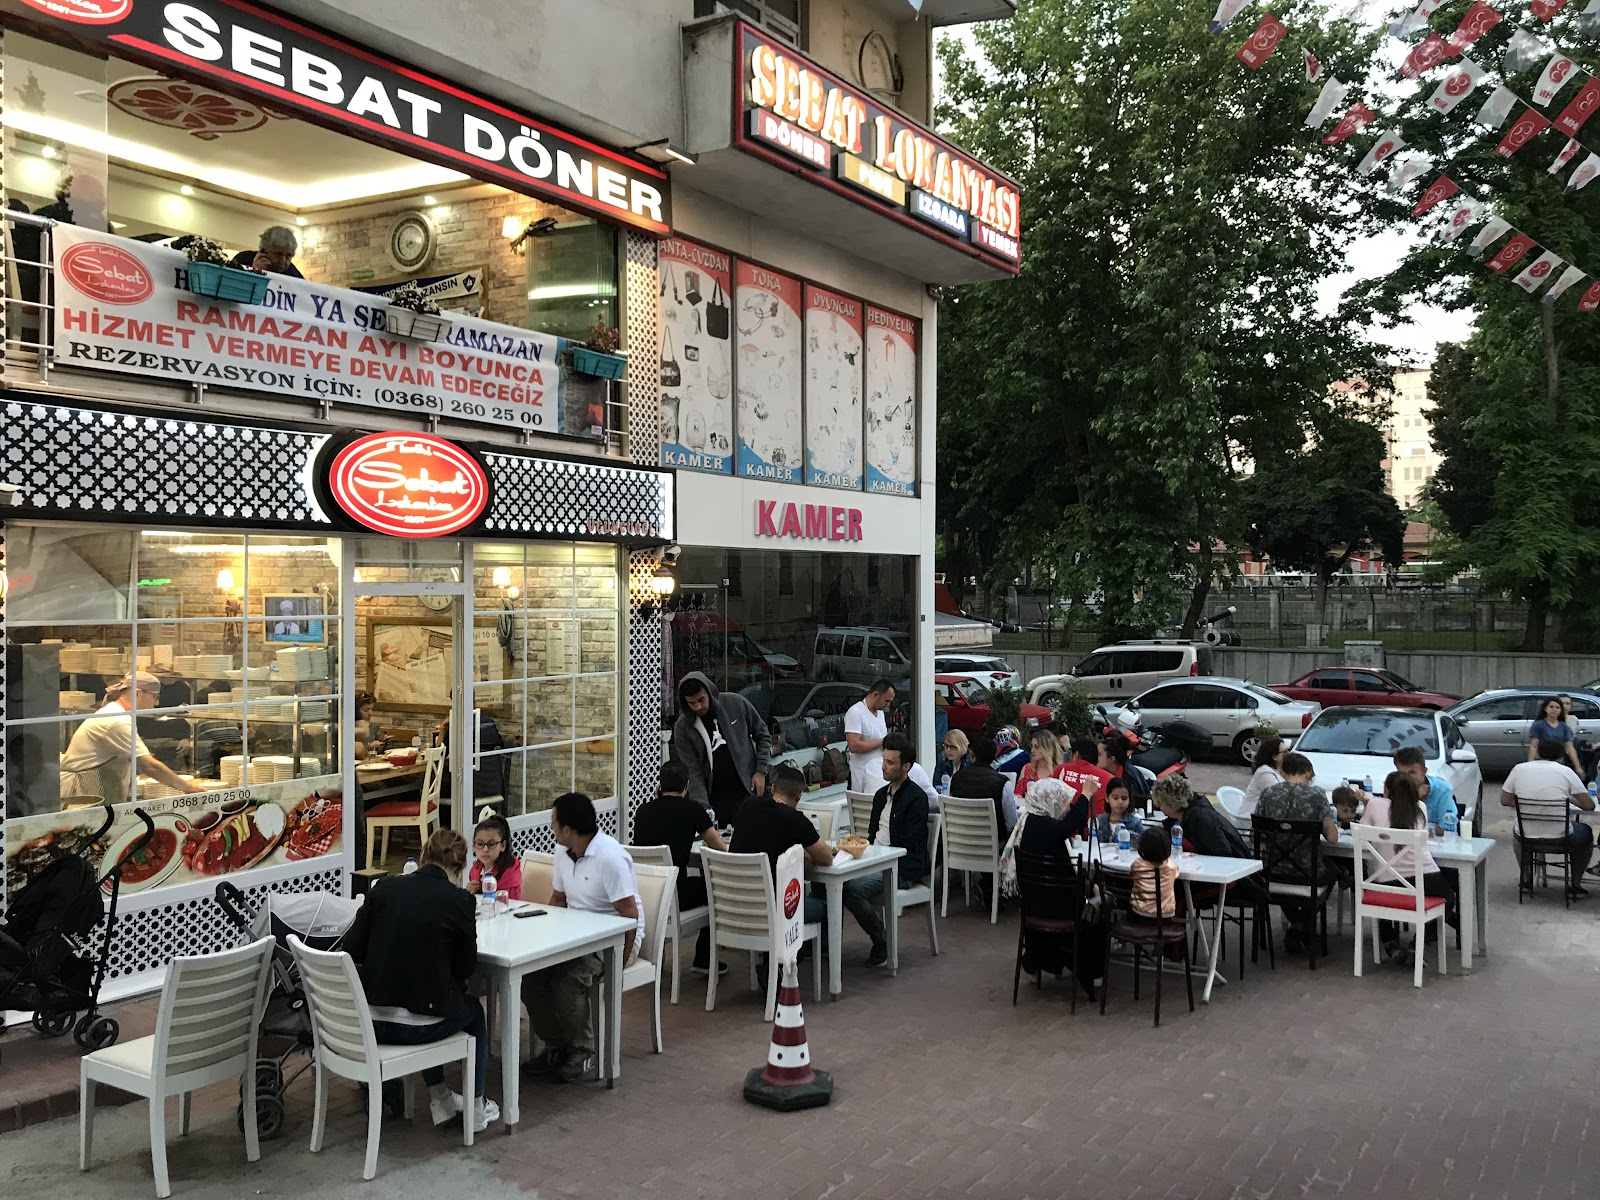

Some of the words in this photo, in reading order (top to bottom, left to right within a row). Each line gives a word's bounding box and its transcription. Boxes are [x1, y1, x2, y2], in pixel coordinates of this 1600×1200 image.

[163, 3, 441, 138] SEBAT
[464, 125, 662, 222] DÖNER
[751, 44, 867, 154] SEBAT
[875, 115, 1020, 237] LOKANTASI
[765, 116, 825, 165] DÖNER
[981, 226, 1018, 258] YEMEK
[72, 256, 144, 284] Sebat
[751, 269, 782, 291] TOKA
[174, 268, 190, 291] H
[262, 284, 297, 312] DİN
[311, 294, 346, 323] YA
[353, 305, 387, 332] ŞE
[422, 278, 458, 297] ZANSIN
[813, 293, 854, 318] OYUNCAK
[868, 308, 914, 335] HEDİYELİK
[177, 300, 347, 349] RAMAZAN
[358, 335, 407, 360] AYI
[418, 346, 544, 386] BOYUNCA
[64, 308, 195, 349] HİZMET
[206, 332, 341, 373] VERMEYE
[350, 357, 435, 387] DEVAM
[441, 374, 543, 407] EDECEĞİZ
[69, 341, 295, 389] REZERVASYON
[304, 374, 361, 398] İÇİN:
[375, 388, 443, 412] (0368)
[451, 400, 485, 417] 260
[492, 407, 514, 421] 25
[520, 411, 543, 426] 00
[665, 452, 724, 470] KAMER
[746, 464, 793, 480] KAMER
[354, 461, 470, 494] Sebat
[814, 473, 858, 489] KAMER
[872, 480, 909, 494] KAMER
[756, 499, 863, 541] KAMER
[172, 796, 198, 810] 0368
[201, 794, 220, 805] 260
[223, 791, 236, 802] 25
[238, 789, 251, 799] 00
[784, 922, 800, 948] VALE
